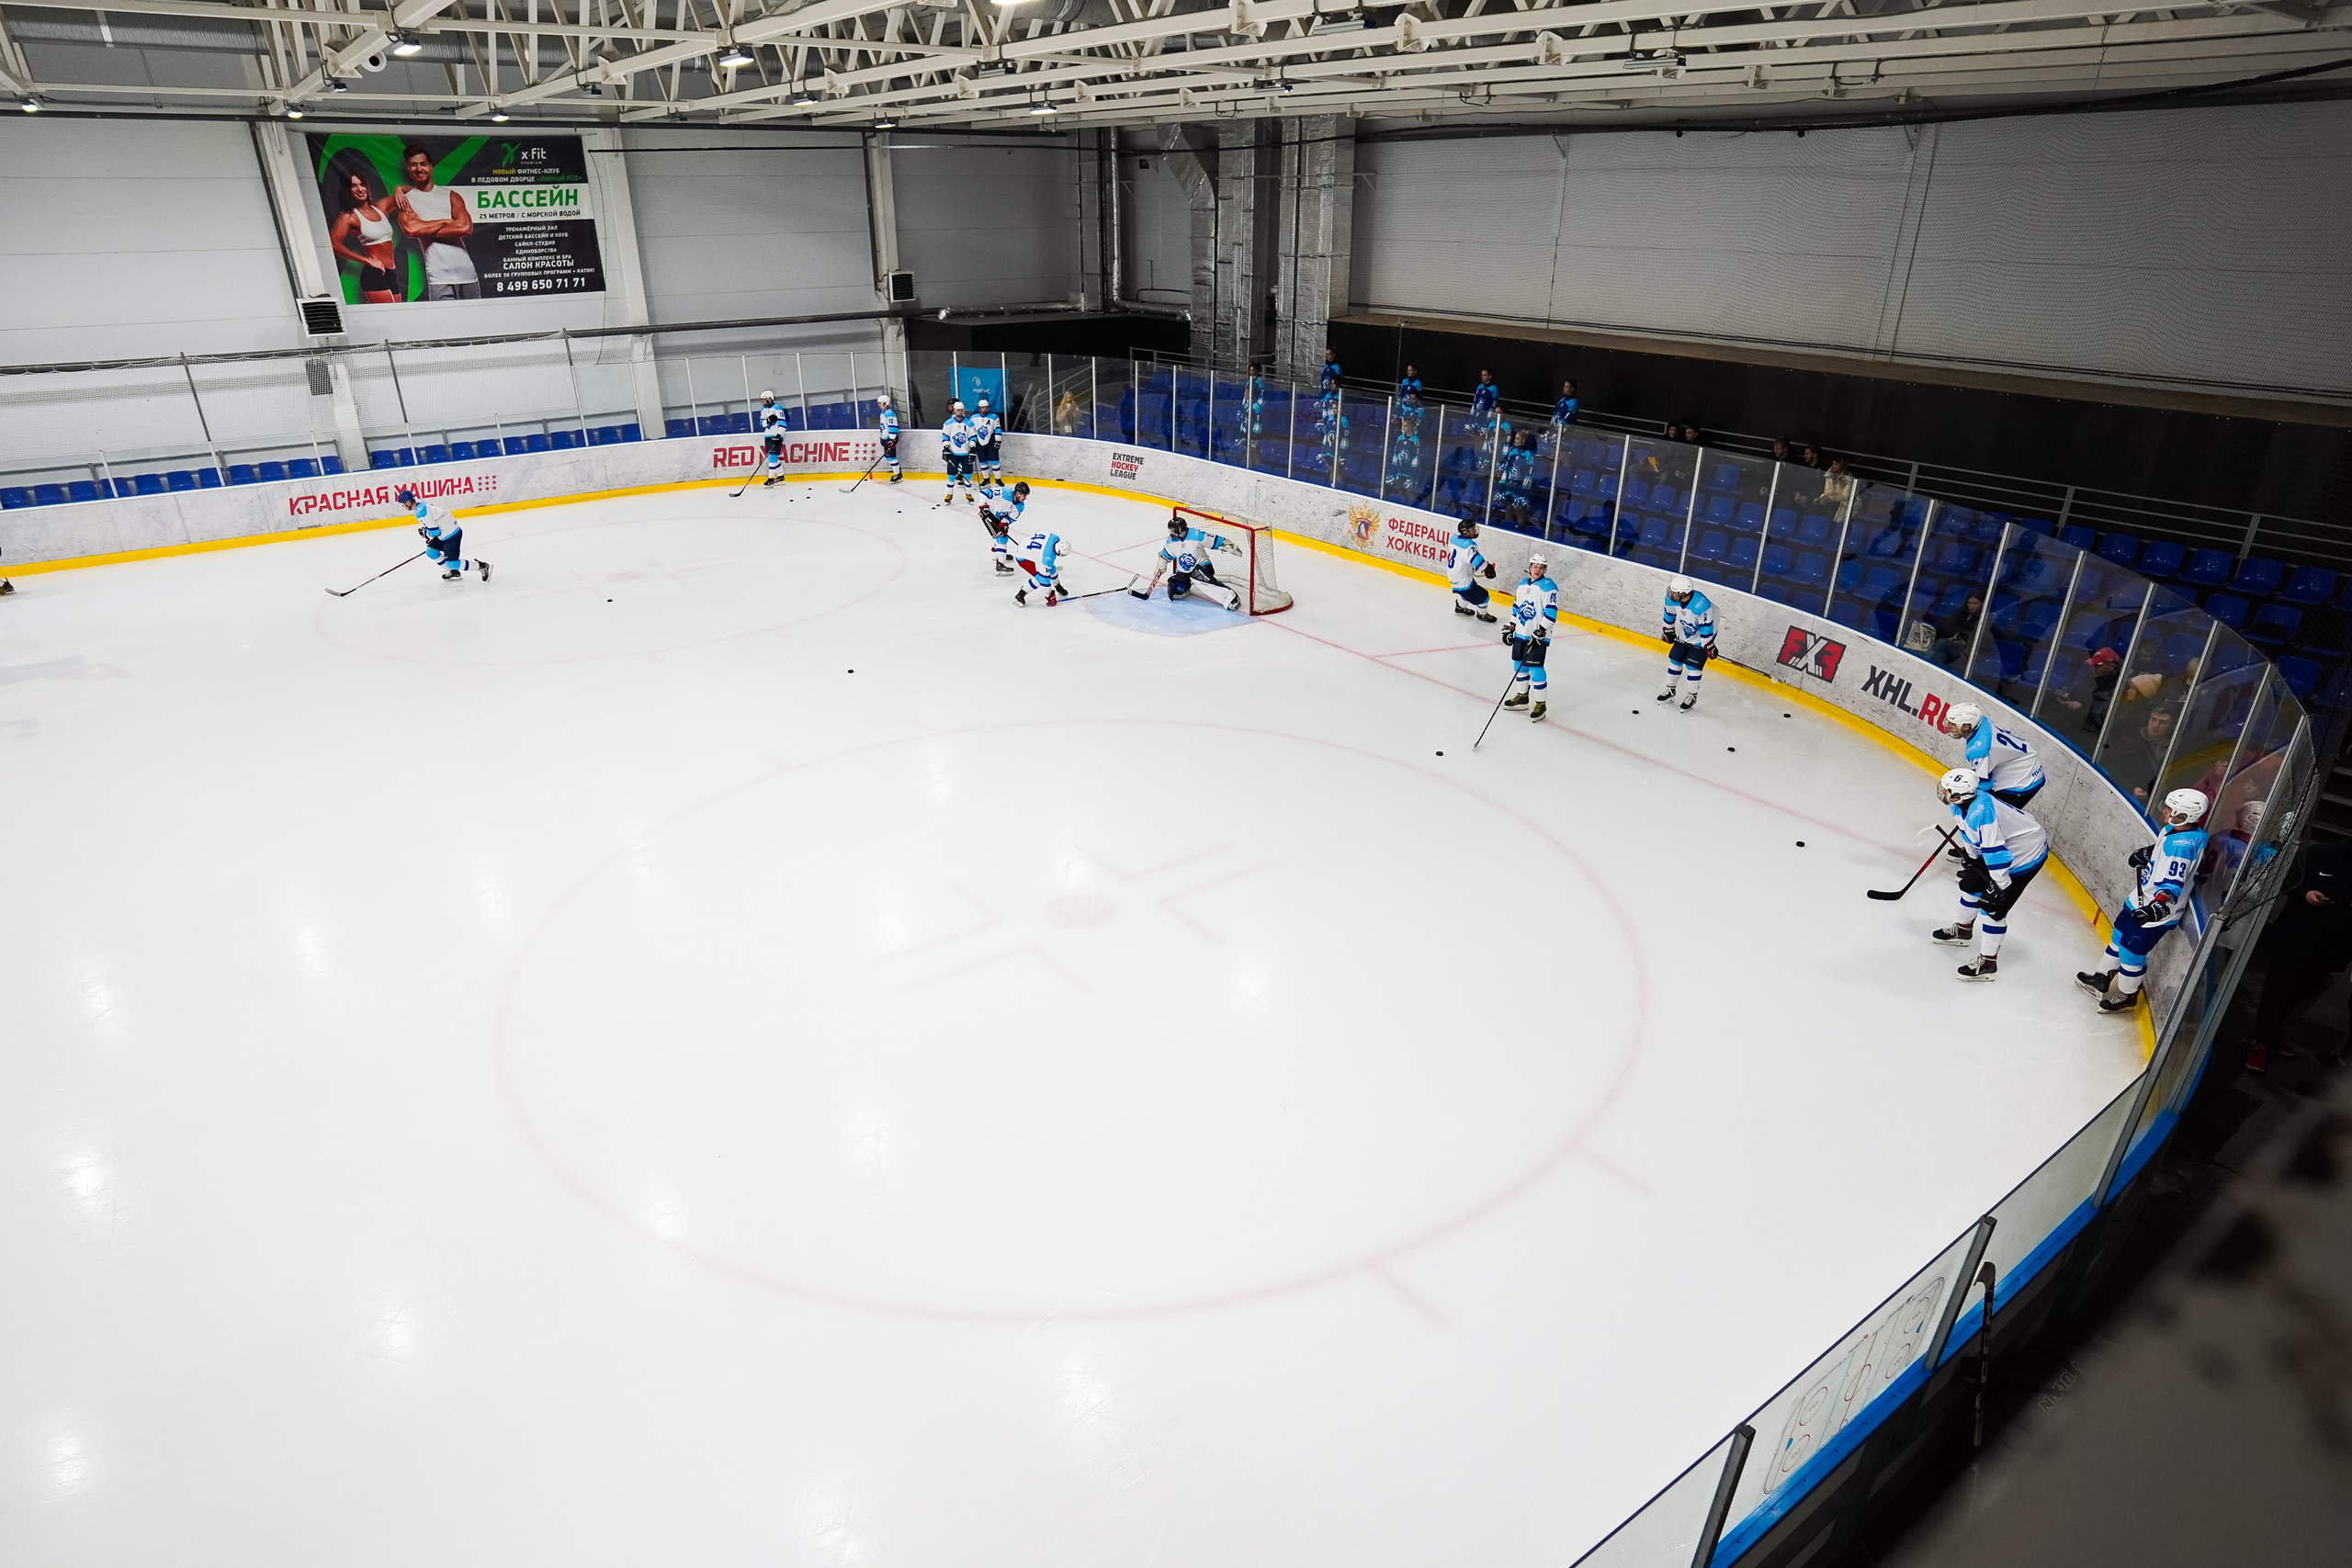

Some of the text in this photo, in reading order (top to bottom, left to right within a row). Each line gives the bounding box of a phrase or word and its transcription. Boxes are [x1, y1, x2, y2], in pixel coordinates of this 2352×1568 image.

[477, 185, 578, 209] БАССЕЙН
[526, 209, 558, 218] МОРСКОЙ
[559, 209, 581, 217] ВОДОЙ
[503, 259, 574, 270] САЛОН КРАСОТЫ
[496, 276, 585, 292] 8 499 650 71 71
[713, 445, 755, 468] RED
[1112, 452, 1145, 466] EXTREME
[1110, 468, 1137, 480] LEAGUE
[1111, 460, 1139, 472] HOCKEY
[288, 476, 474, 516] КРАСНАЯ МАШИНА
[1385, 536, 1436, 561] ХОККЕЯ
[2168, 861, 2187, 879] 93
